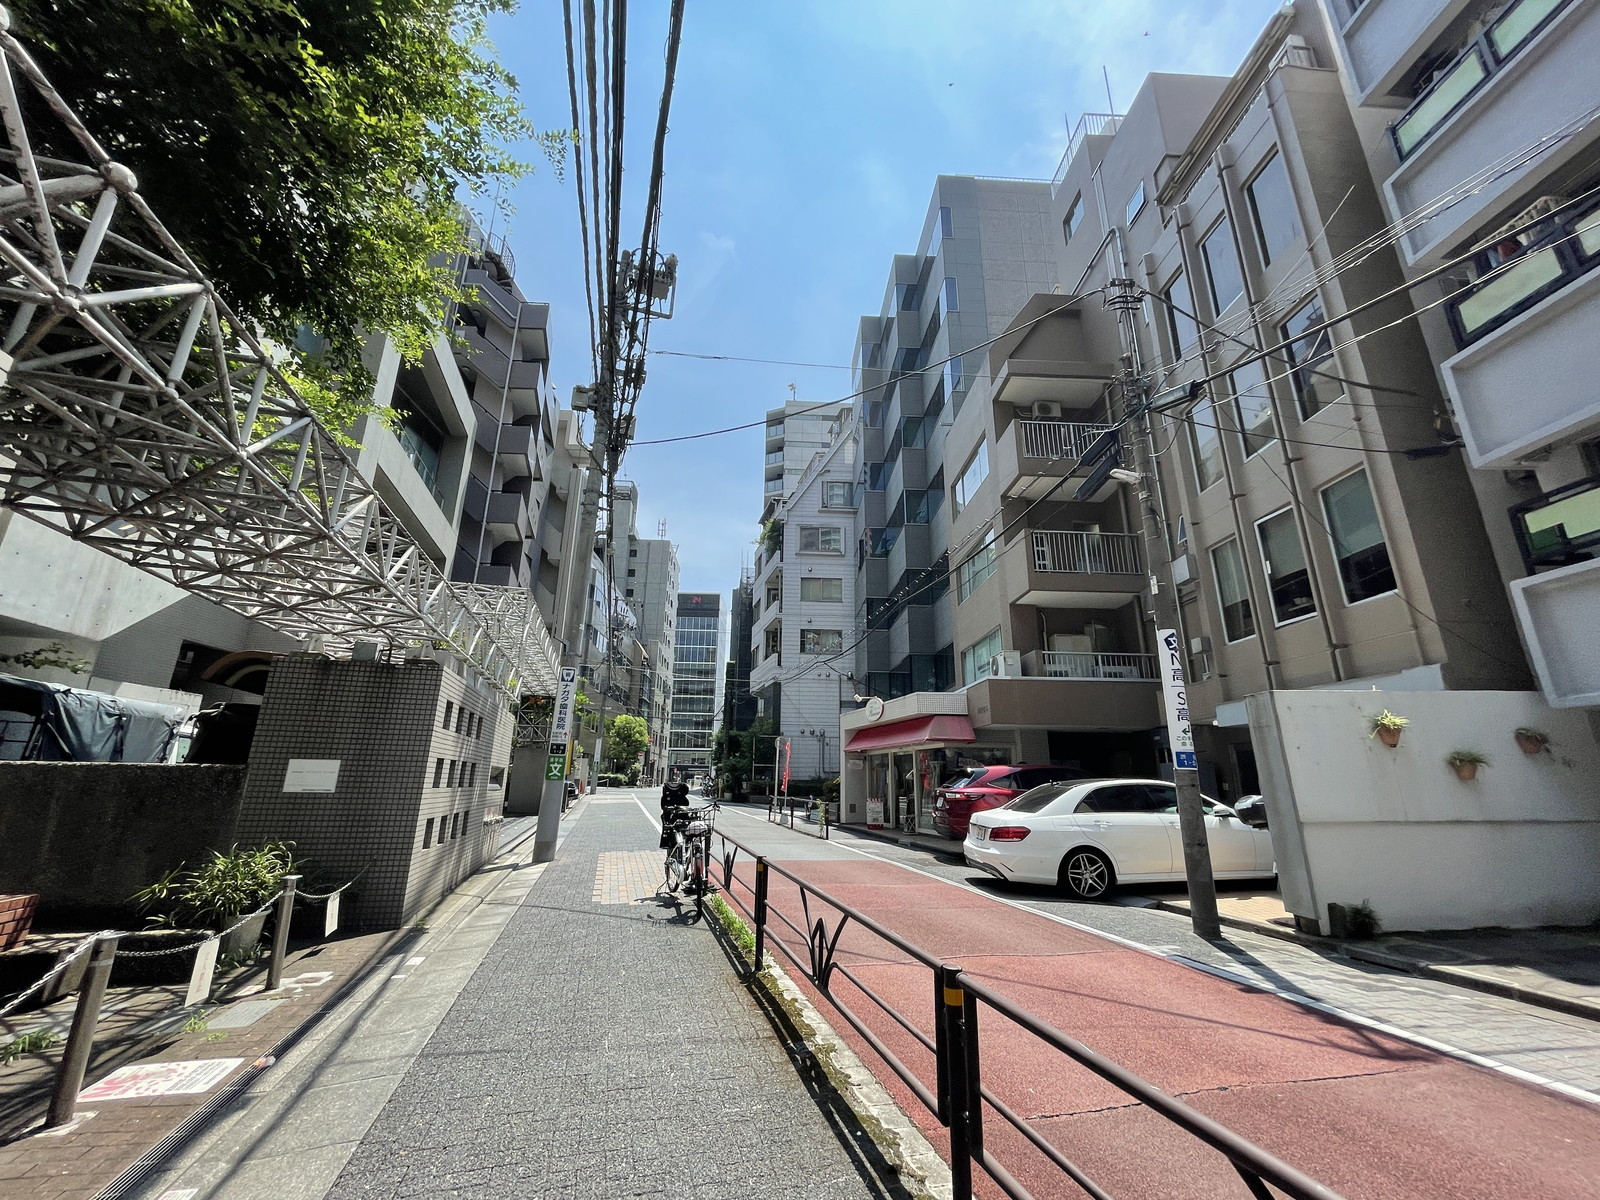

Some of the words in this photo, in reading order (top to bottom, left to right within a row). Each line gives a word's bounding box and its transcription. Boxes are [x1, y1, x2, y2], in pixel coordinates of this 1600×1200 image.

[556, 684, 571, 731] ナガタ歯科医院
[548, 763, 562, 776] 文
